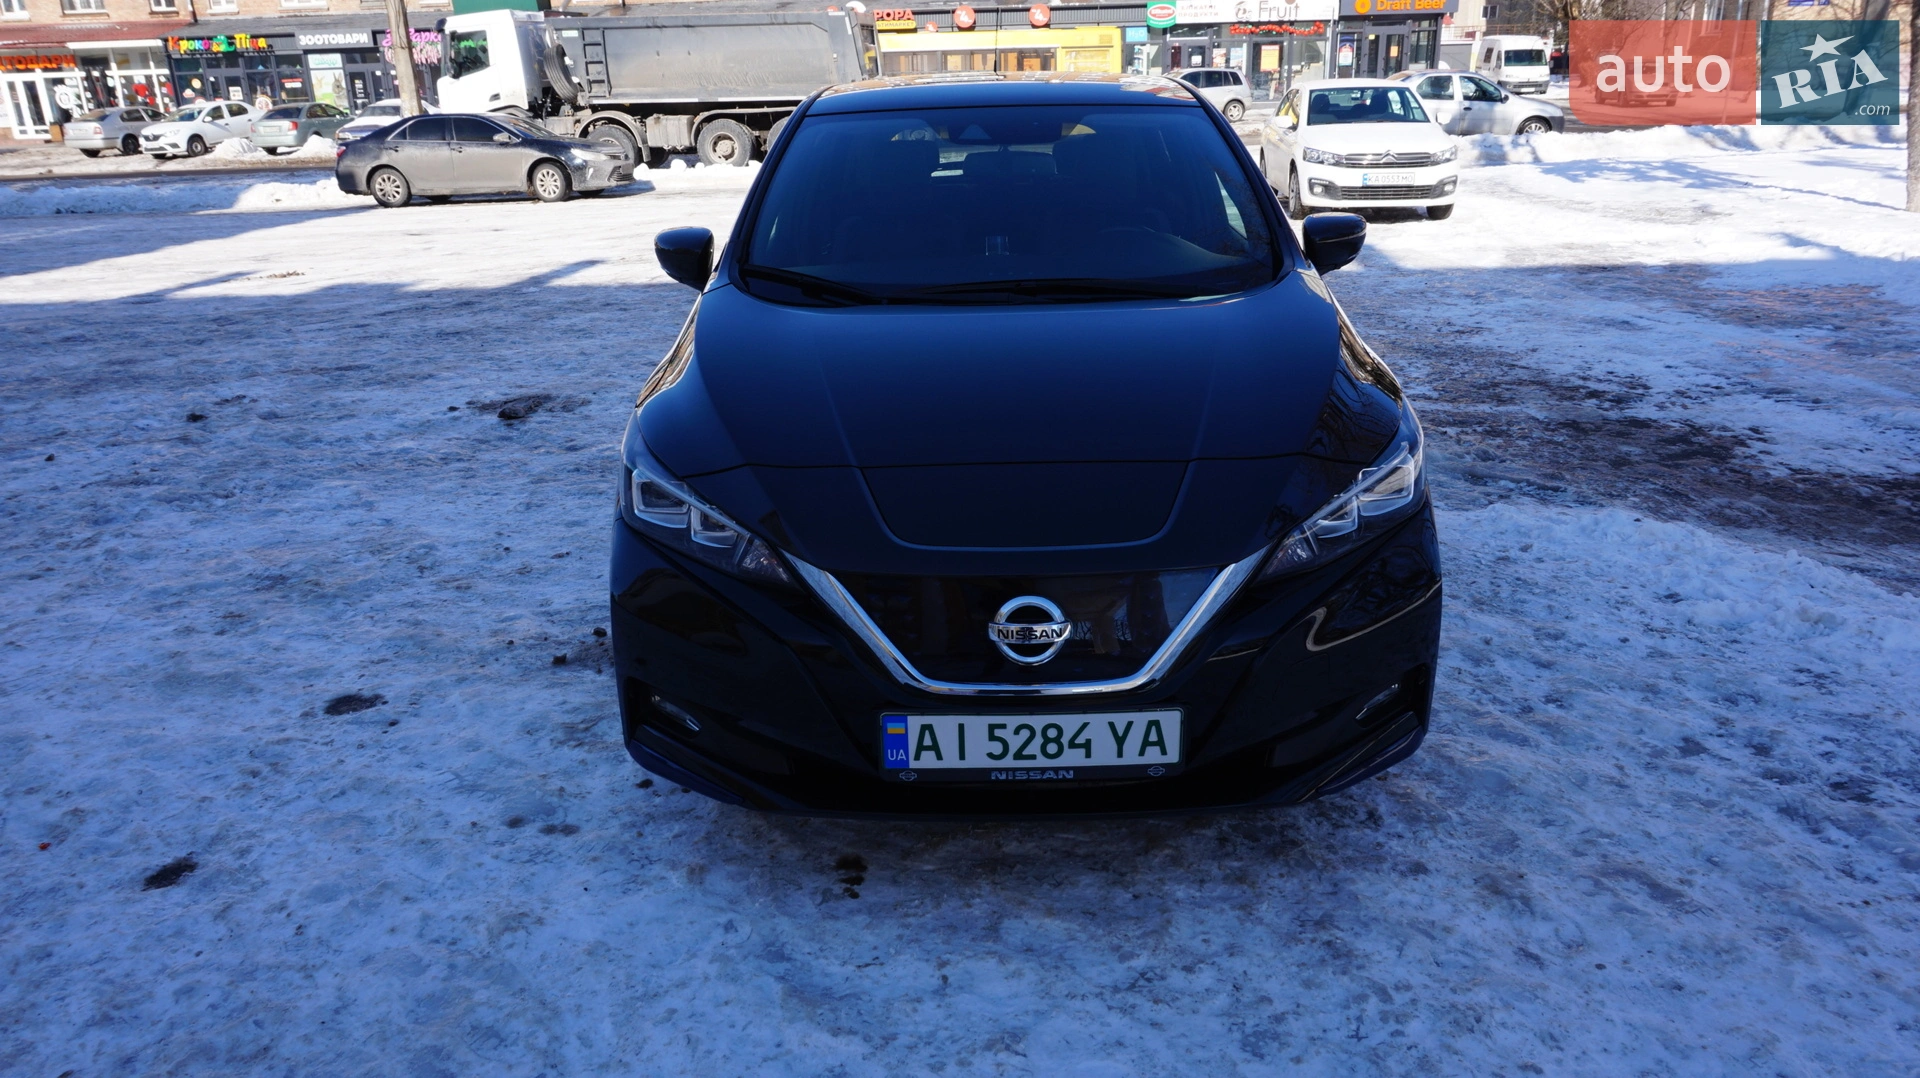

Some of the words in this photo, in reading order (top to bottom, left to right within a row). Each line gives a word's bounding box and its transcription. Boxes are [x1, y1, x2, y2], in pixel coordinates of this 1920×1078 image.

[1258, 0, 1300, 18] Fruit
[1376, 0, 1411, 11] Draft
[1414, 0, 1446, 10] Beer
[168, 36, 210, 54] Кроко
[234, 33, 267, 50] Піца
[299, 33, 369, 46] ЗООТОВАРИ
[997, 627, 1063, 640] NISSAN
[913, 722, 966, 761] AI
[985, 721, 1092, 761] 5284
[1107, 719, 1168, 759] YA
[888, 749, 907, 761] UA
[991, 769, 1074, 780] NISSAN
